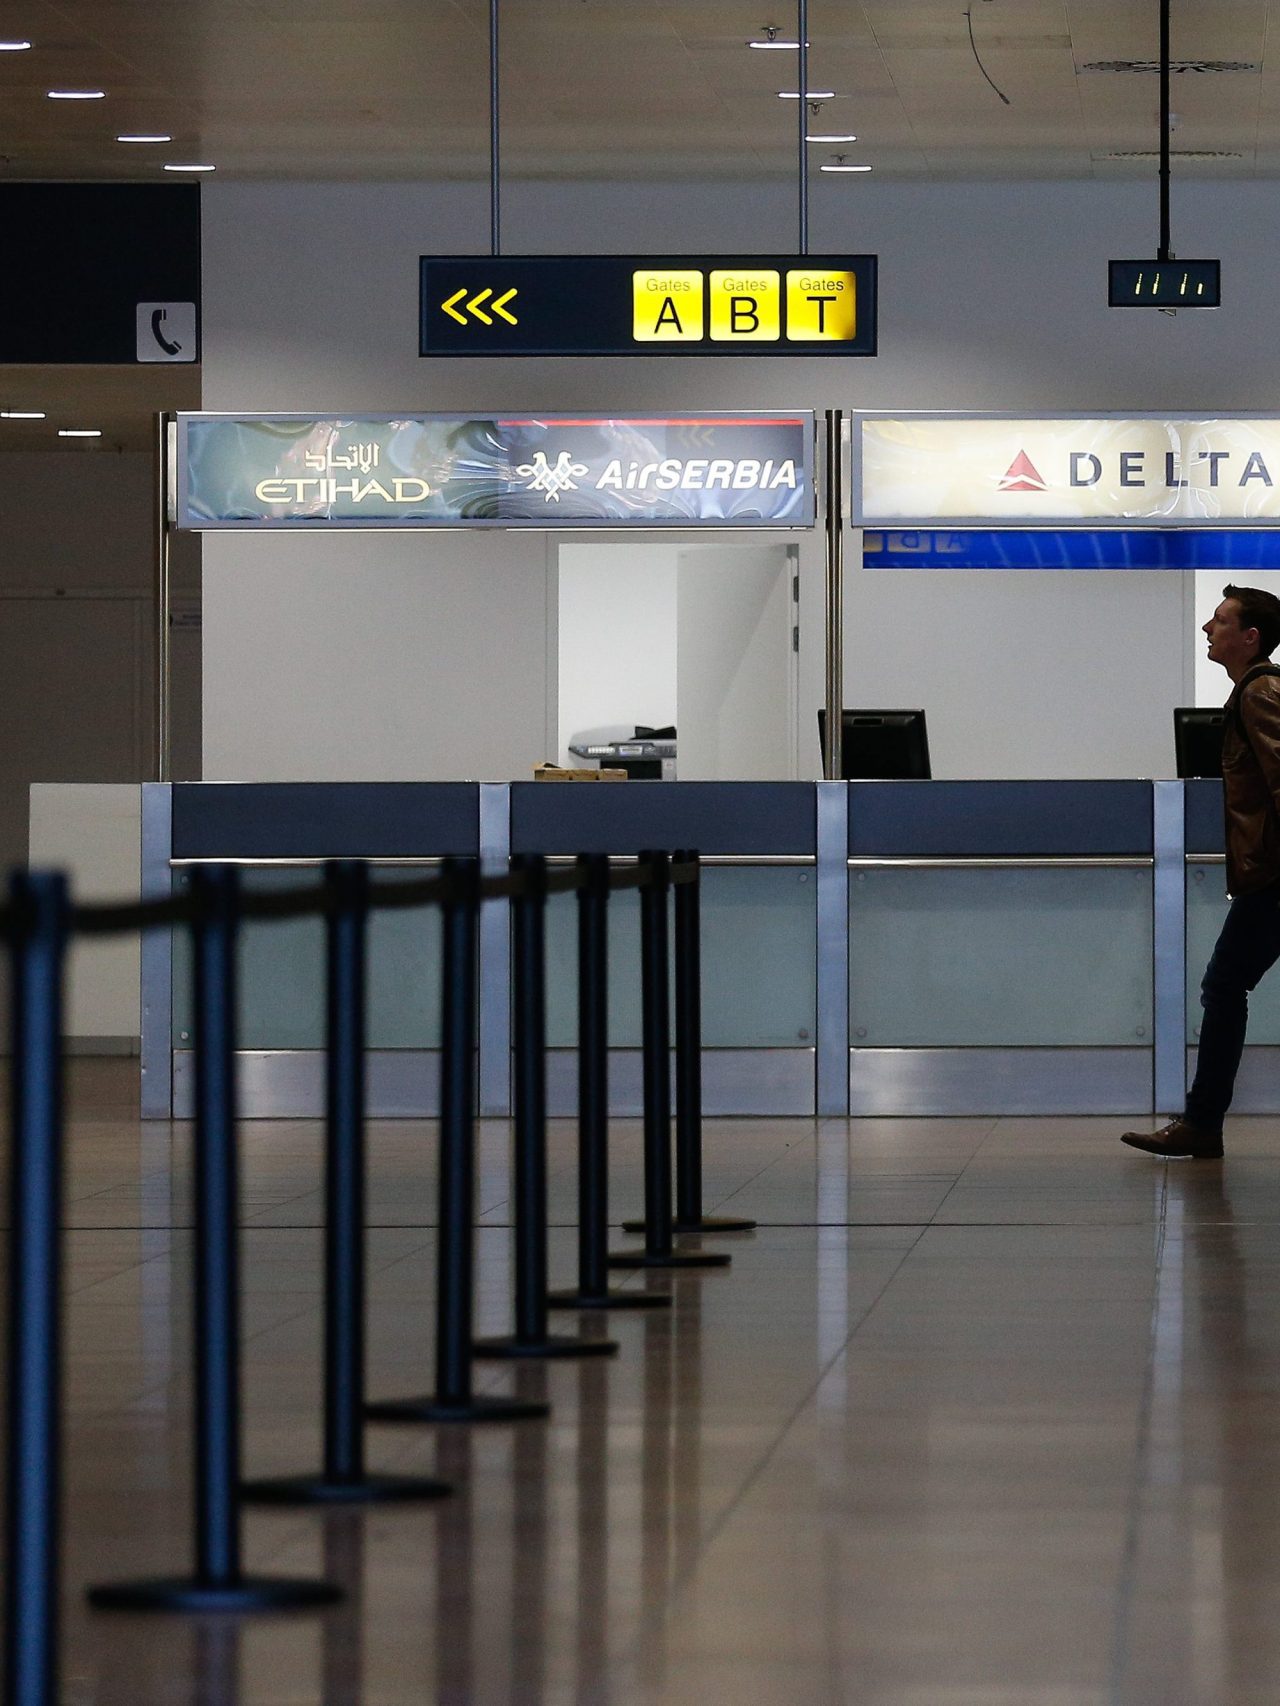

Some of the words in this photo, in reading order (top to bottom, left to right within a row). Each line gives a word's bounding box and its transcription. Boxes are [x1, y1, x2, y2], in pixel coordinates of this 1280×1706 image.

[646, 276, 691, 292] Gates
[722, 276, 768, 292] Gates
[799, 276, 845, 292] Gates
[653, 296, 683, 334] A
[730, 296, 760, 334] B
[806, 296, 837, 334] T
[595, 458, 797, 490] AirSERBIA
[1070, 451, 1274, 488] DELTA
[254, 477, 431, 503] ETIHAD
